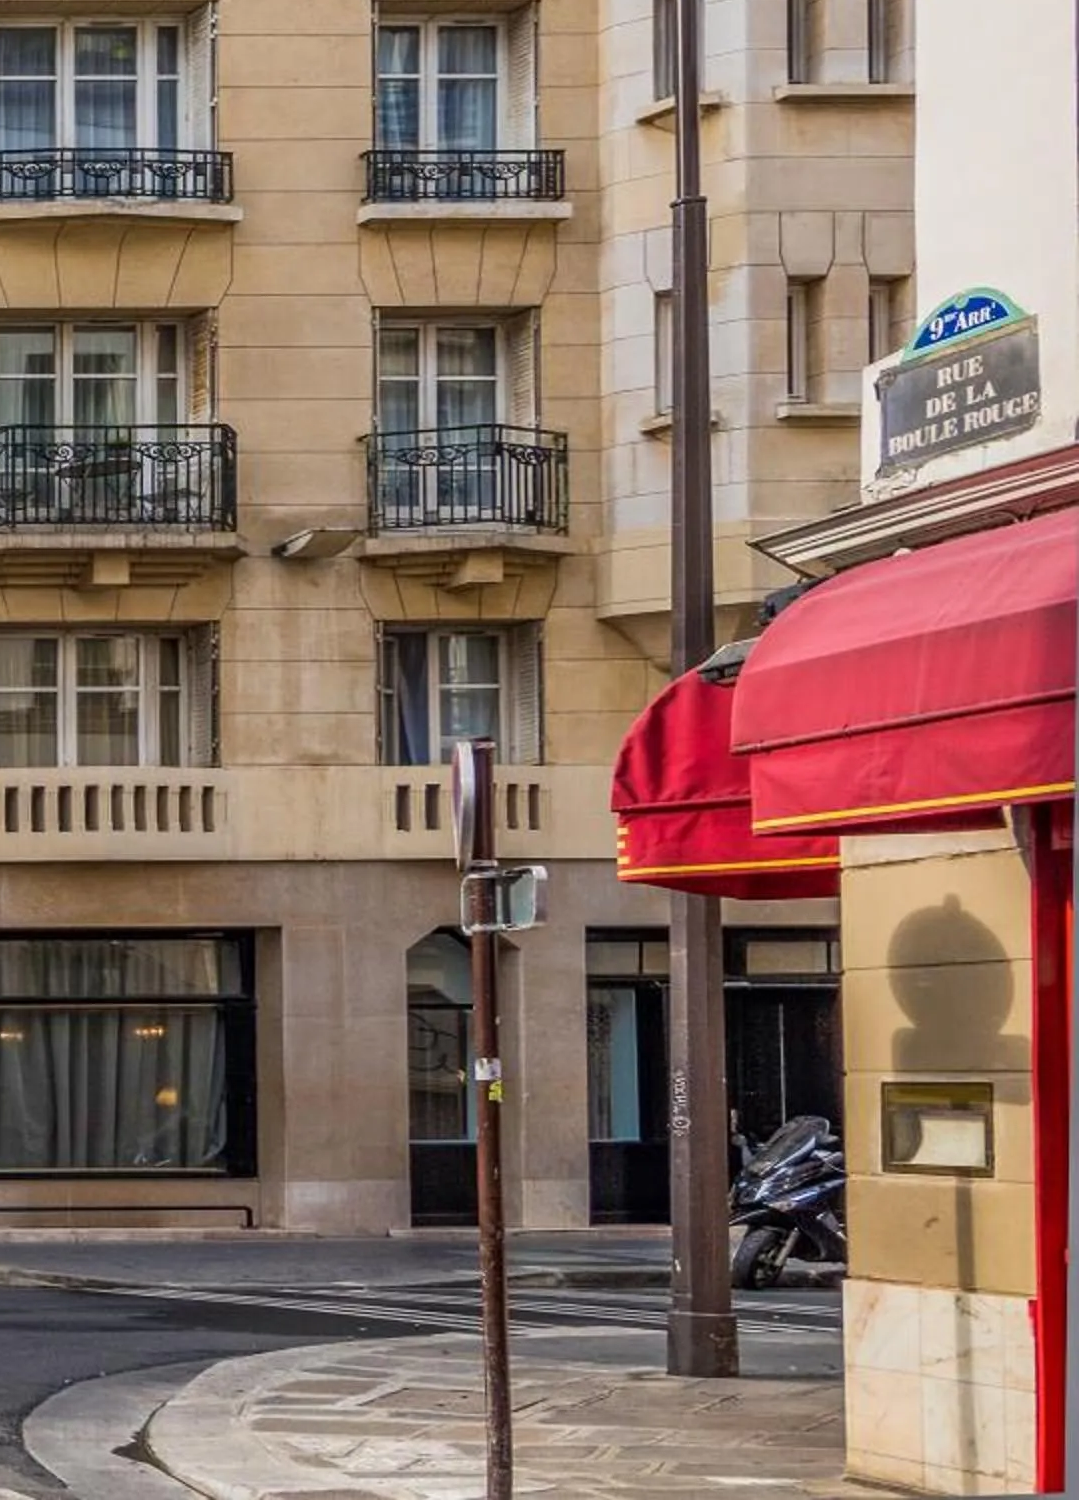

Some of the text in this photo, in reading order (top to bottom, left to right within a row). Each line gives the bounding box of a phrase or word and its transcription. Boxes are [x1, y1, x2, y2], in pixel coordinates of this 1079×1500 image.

[936, 356, 983, 388] RUE
[926, 381, 997, 418] DE LA
[888, 391, 1038, 455] BOULE ROUGE
